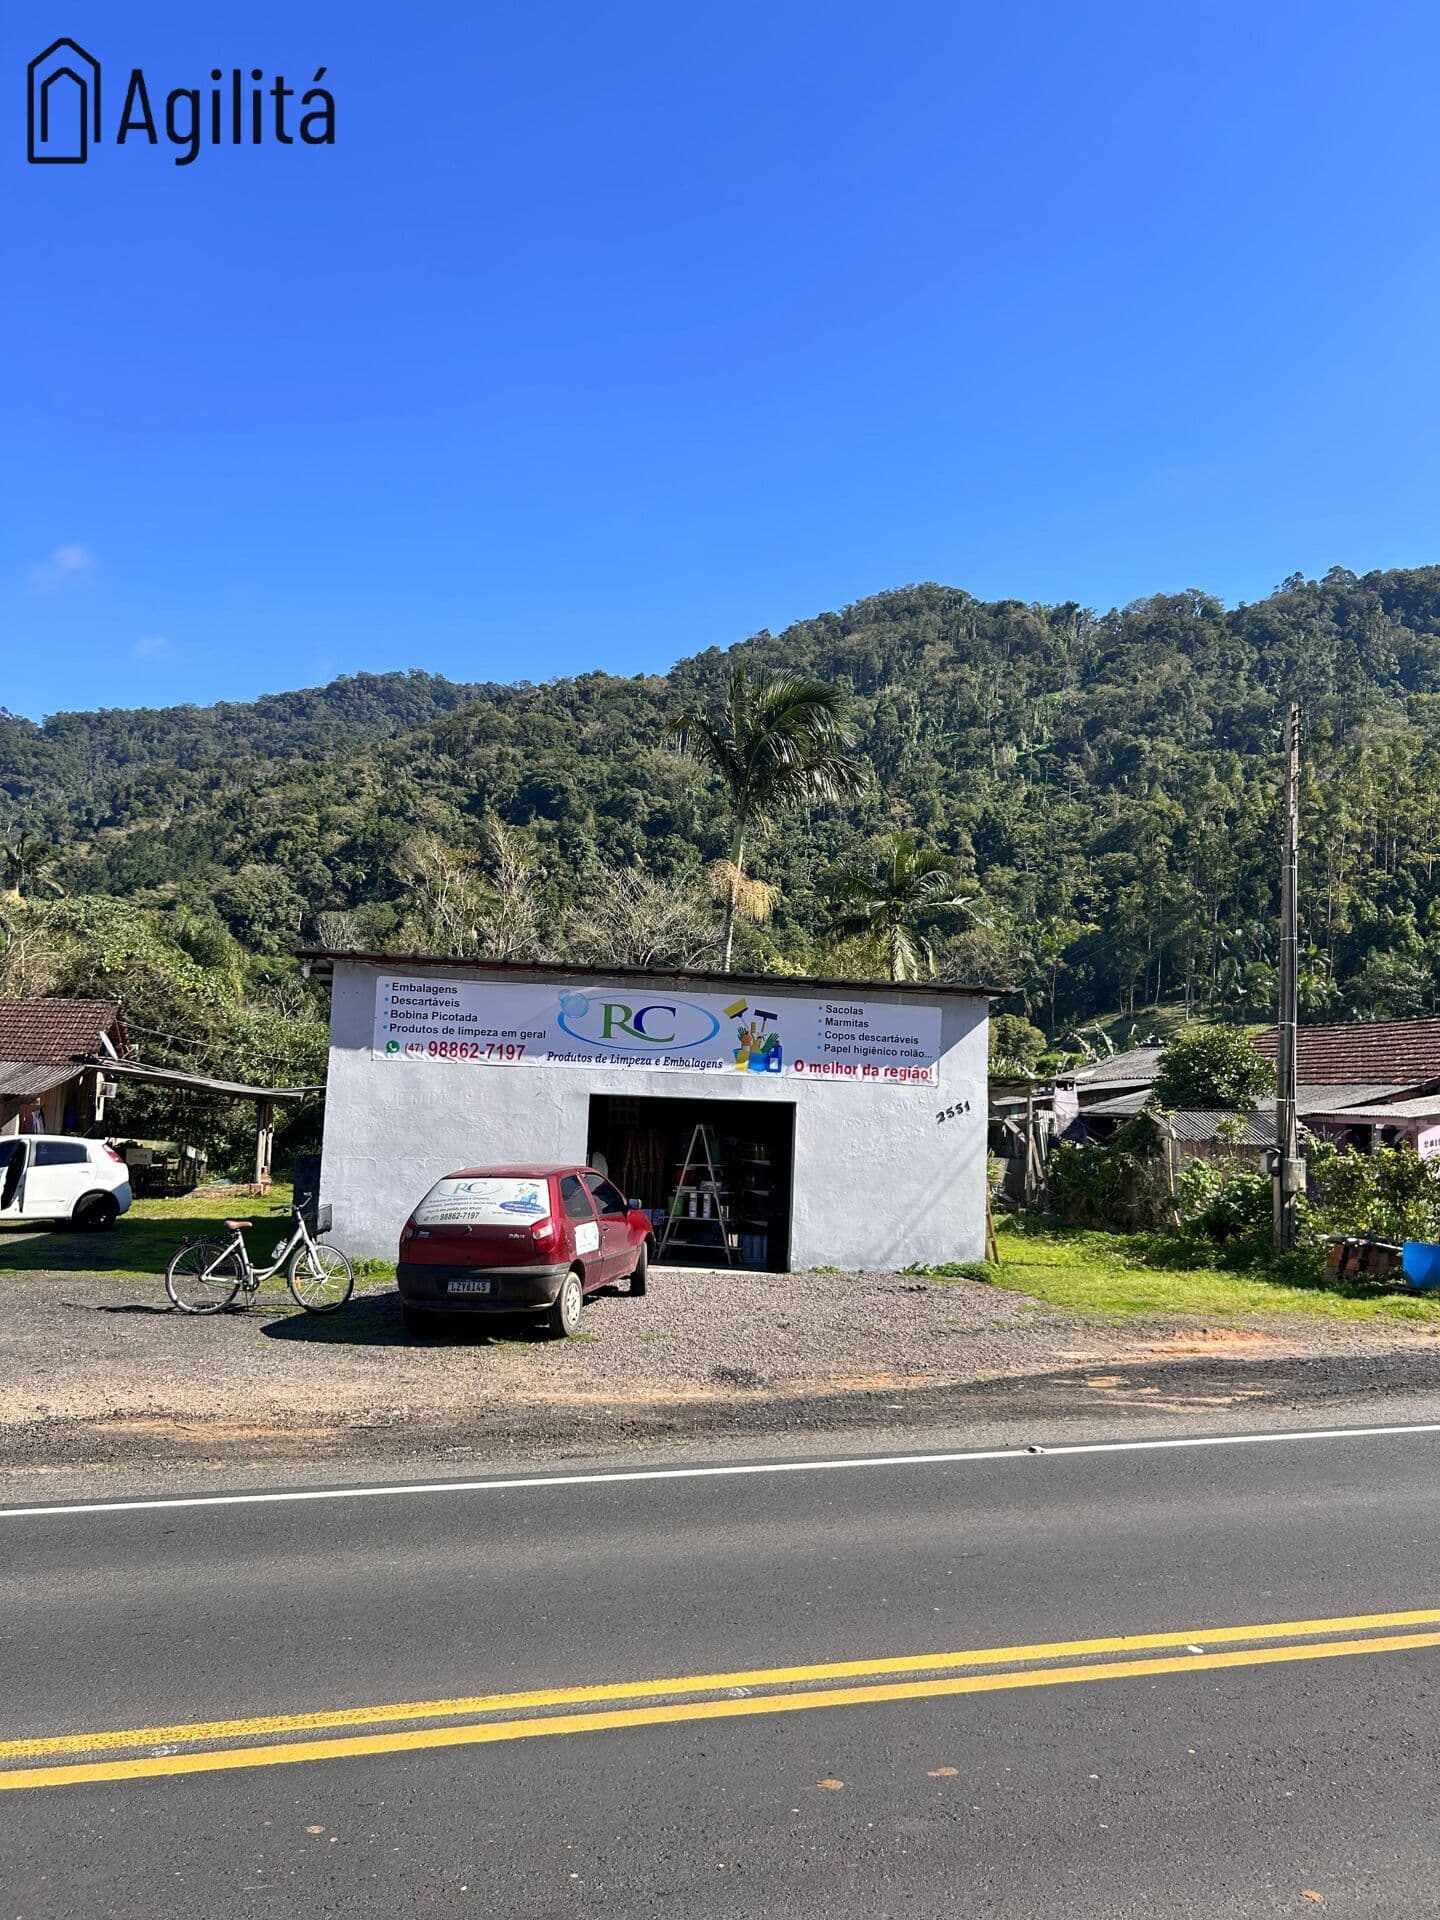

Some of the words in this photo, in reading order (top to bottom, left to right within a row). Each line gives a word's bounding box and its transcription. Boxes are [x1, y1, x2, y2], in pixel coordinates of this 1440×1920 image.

[392, 982, 458, 994] Embalagens
[391, 995, 460, 1007] Descartáveis
[390, 1010, 428, 1020] Bobina
[432, 1011, 478, 1023] Picotada
[826, 1004, 864, 1016] Sacolas
[600, 1003, 677, 1043] RC
[825, 1017, 869, 1028] Marmitas
[389, 1023, 439, 1035] Produtos
[442, 1025, 455, 1035] de
[458, 1027, 498, 1039] limpeza
[501, 1030, 517, 1038] em
[520, 1030, 546, 1041] geral
[824, 1030, 856, 1041] Copos
[858, 1032, 919, 1045] descartáveis
[404, 1043, 424, 1056] (47)
[428, 1040, 526, 1061] 98862-7197
[824, 1043, 851, 1055] Papel
[853, 1045, 898, 1058] higiênico
[547, 1051, 592, 1064] Produtos
[595, 1053, 607, 1064] de
[610, 1054, 652, 1068] Limpeza
[654, 1058, 661, 1066] e
[663, 1057, 723, 1071] Embalagens
[794, 1059, 804, 1072] O
[809, 1061, 858, 1075] melhor
[863, 1063, 879, 1077] da
[884, 1065, 933, 1081] região!
[935, 1100, 971, 1125] 2551
[453, 1181, 487, 1195] RC
[440, 1211, 480, 1221] 98862-7197
